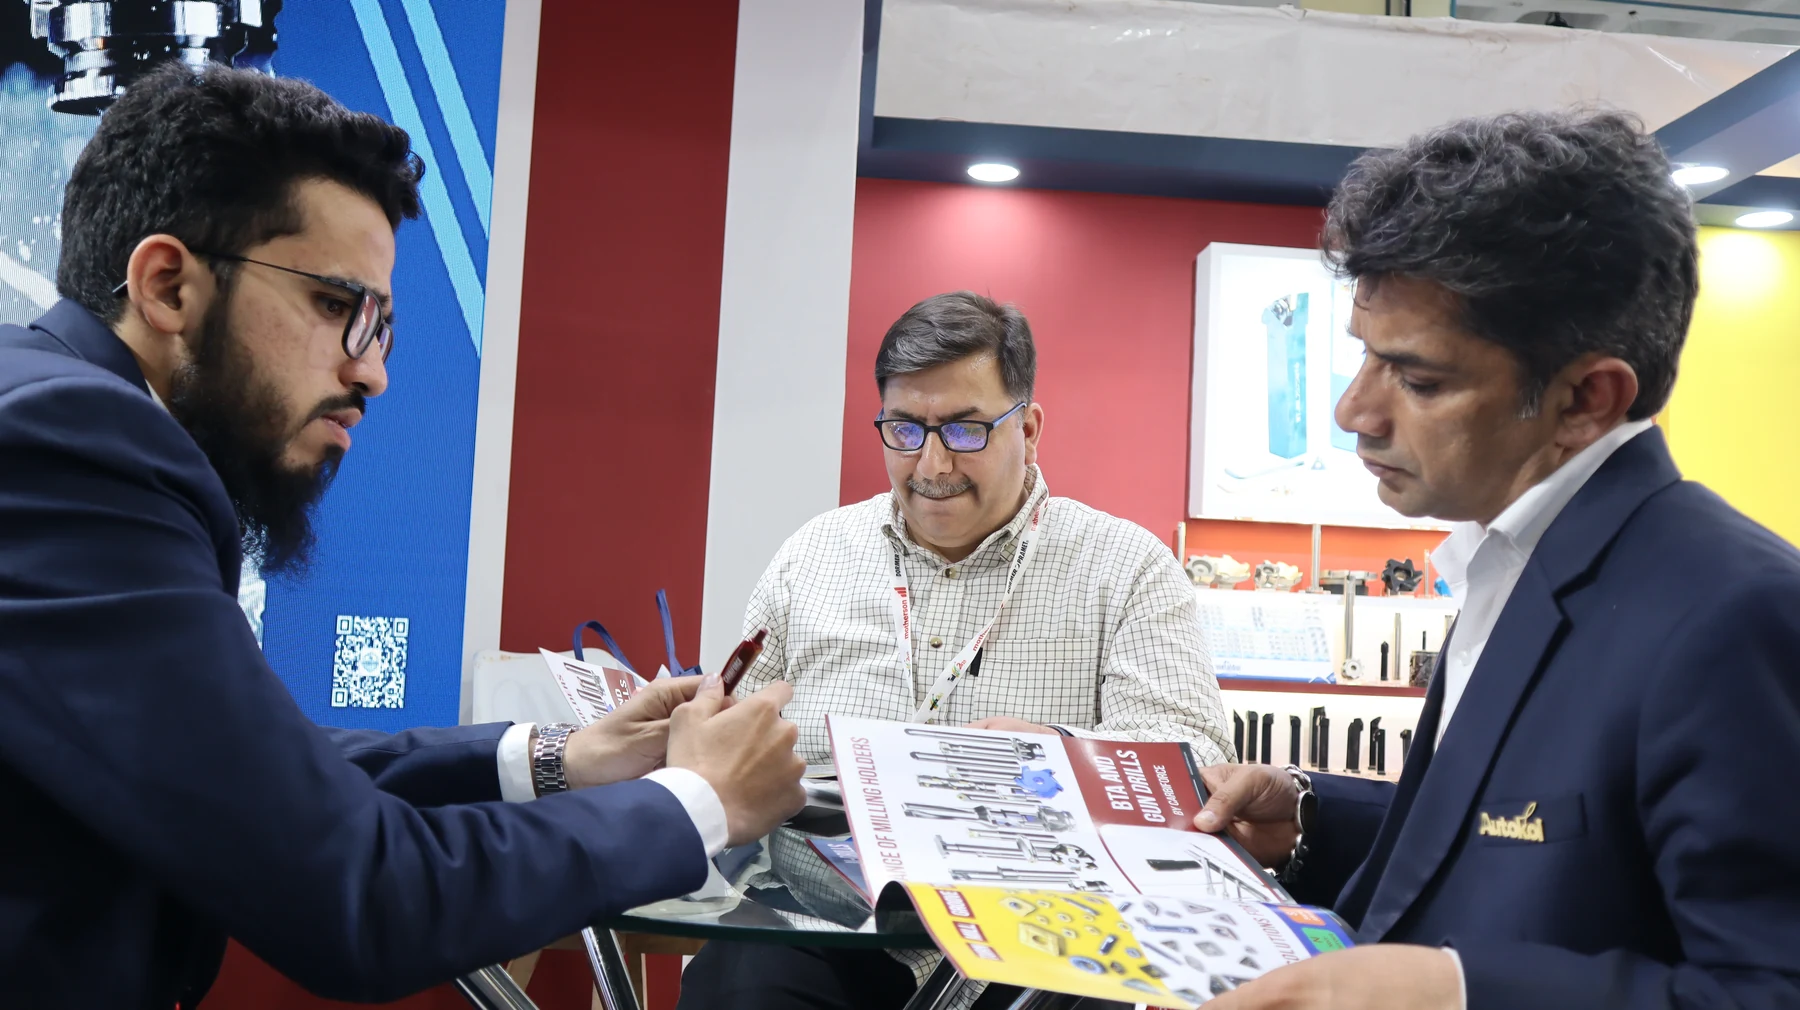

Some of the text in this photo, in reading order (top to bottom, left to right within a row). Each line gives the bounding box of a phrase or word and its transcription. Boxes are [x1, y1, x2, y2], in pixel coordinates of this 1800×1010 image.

[901, 599, 909, 640] motherson
[850, 737, 908, 881] ANGE OF MILLING HOLDERS
[1094, 755, 1134, 811] BTA AND
[1116, 749, 1166, 823] GUN DRILLS
[1153, 764, 1184, 816] BY CARBIFORCE
[1253, 917, 1299, 965] OLUTIONS
